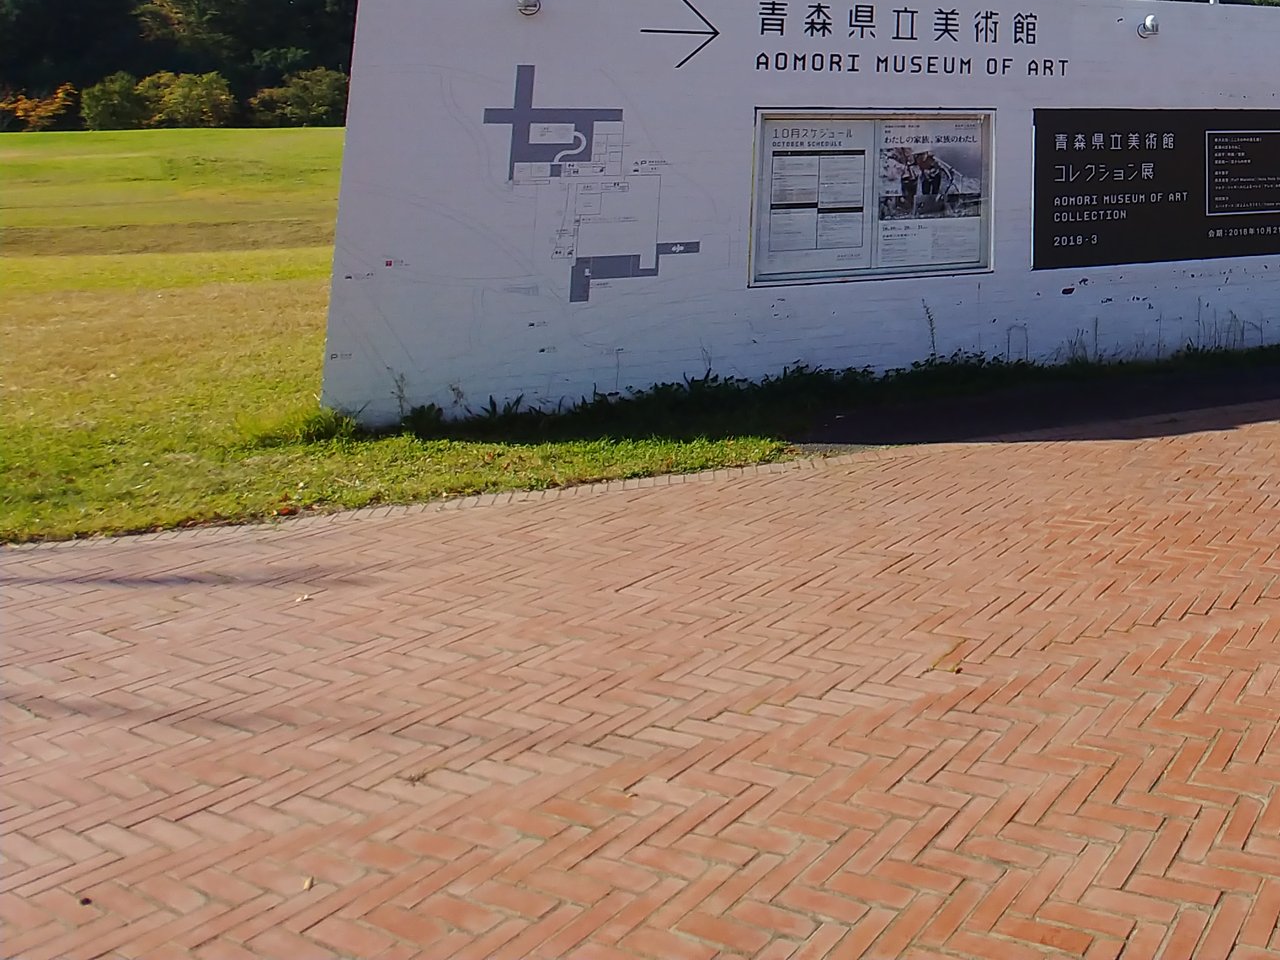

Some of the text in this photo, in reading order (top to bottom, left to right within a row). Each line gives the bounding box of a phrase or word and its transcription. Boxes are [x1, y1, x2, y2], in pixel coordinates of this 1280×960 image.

[759, 1, 1037, 44] 青森県立美術館
[756, 52, 1068, 76] AOMORI MUSEUM OF ART
[1054, 133, 1175, 150] 青森県立美術館
[1054, 163, 1154, 182] コレクション展
[1054, 192, 1188, 206] AOMORI MUSEUM OF ART
[1054, 210, 1127, 222] COLLECTION
